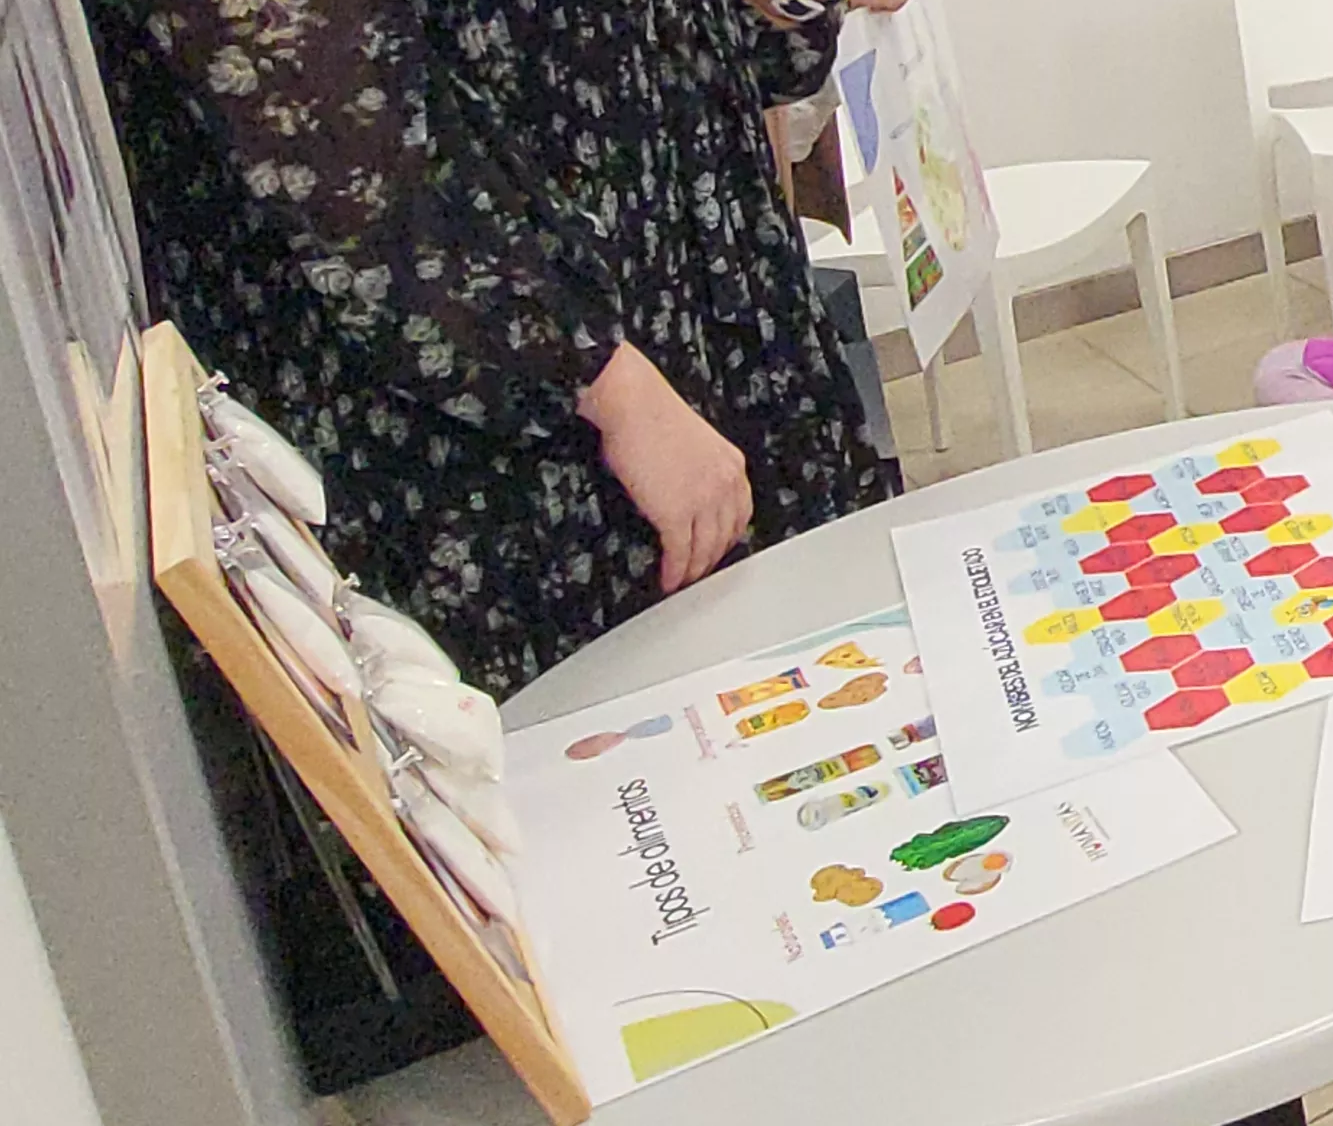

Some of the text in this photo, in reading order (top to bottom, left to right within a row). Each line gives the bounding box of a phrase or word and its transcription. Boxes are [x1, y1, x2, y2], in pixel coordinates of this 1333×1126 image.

[961, 547, 997, 599] ETIQUETADO
[982, 620, 1017, 661] AZÚCAR
[998, 660, 1022, 680] DEL
[1002, 676, 1040, 733] NOMBRES
[612, 778, 711, 946] Tipos de alimentos
